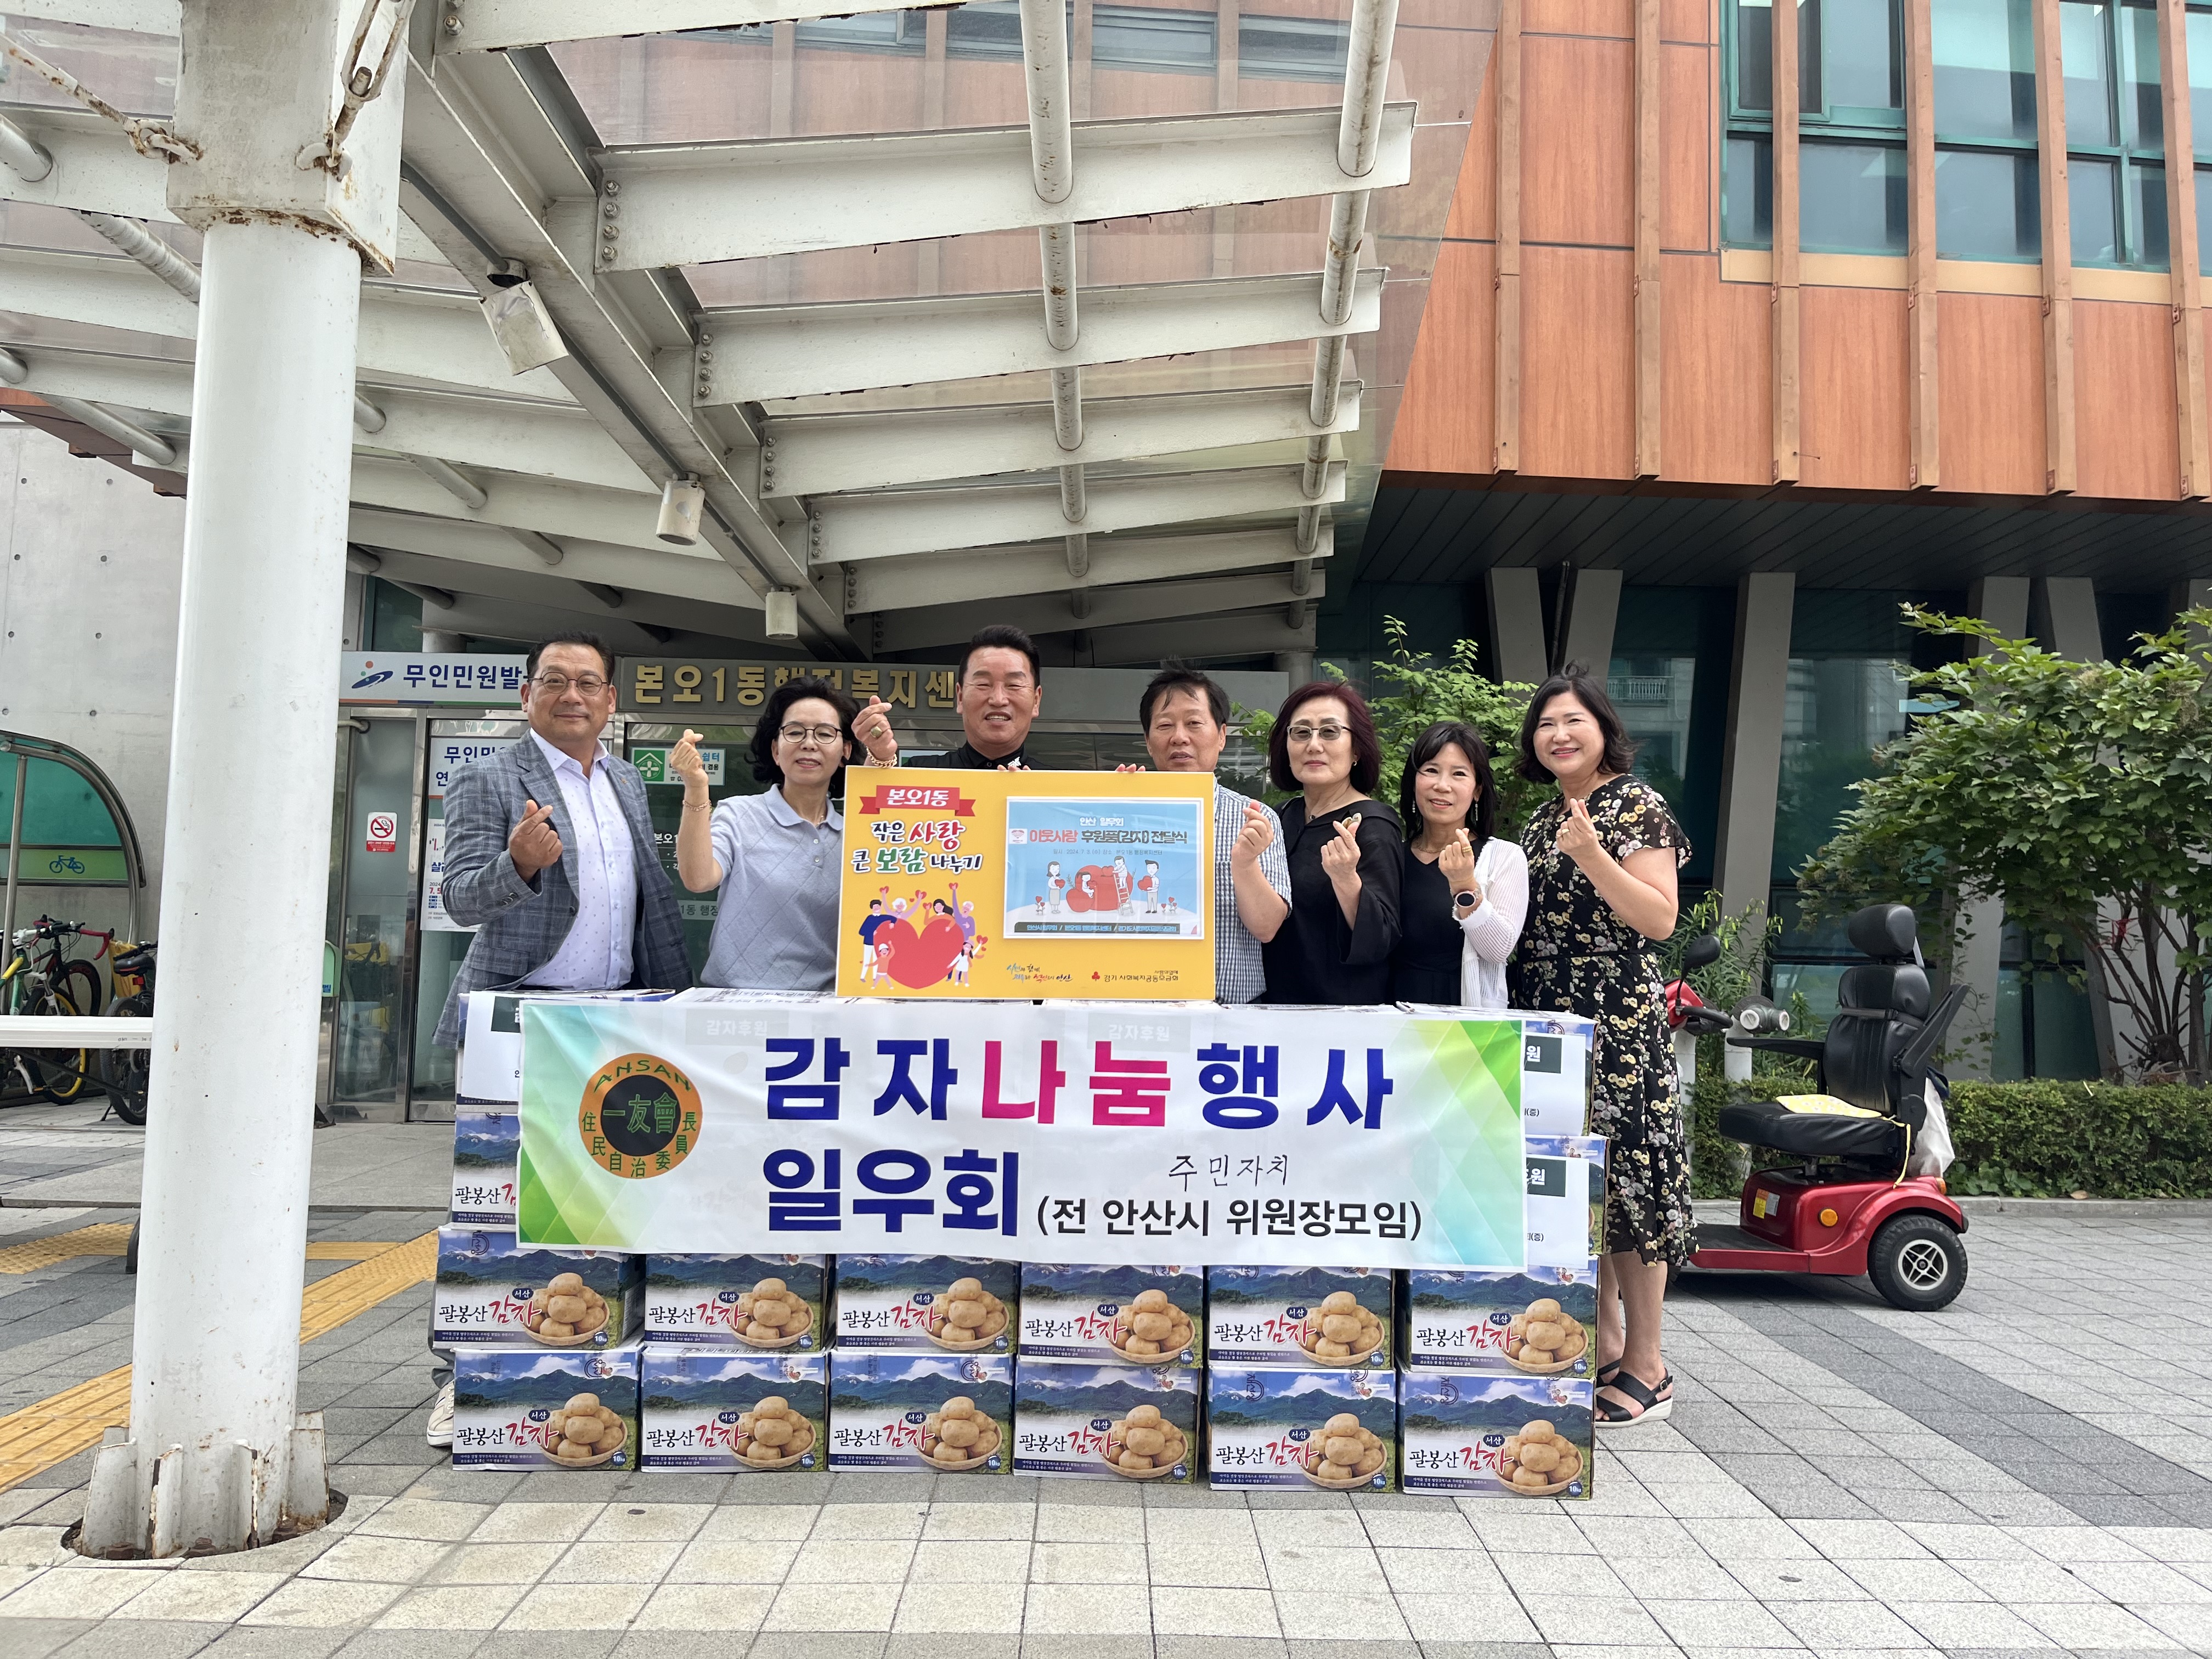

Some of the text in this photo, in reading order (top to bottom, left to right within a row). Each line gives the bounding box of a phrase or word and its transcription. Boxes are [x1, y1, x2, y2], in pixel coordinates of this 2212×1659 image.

[404, 664, 529, 690] 무인민원발
[887, 788, 950, 807] 본오1동
[872, 821, 964, 850] 작은 사랑
[1079, 816, 1097, 827] 안산
[1029, 829, 1187, 844] 이웃사랑 후원품(감자) 전달식
[853, 847, 981, 873] 큰 보람 나누기
[593, 1059, 692, 1093] ANSAN
[603, 1092, 678, 1134] 一友會
[455, 1186, 501, 1205] 팔봉산
[763, 1148, 1019, 1237] 일우회
[1037, 1195, 1423, 1242] (전 안산시 위원장모임)
[515, 1290, 531, 1298] 서산
[721, 1293, 737, 1301] 서산
[916, 1295, 931, 1304] 서산
[439, 1295, 541, 1327] 팔봉산 감자
[649, 1297, 748, 1329] 팔봉산 감자
[842, 1299, 943, 1331] 팔봉산 감자
[1099, 1306, 1116, 1314] 서산
[1289, 1308, 1305, 1317] 서산
[1492, 1314, 1509, 1323] 서산
[1025, 1310, 1127, 1344] 팔봉산 감자
[1214, 1313, 1317, 1346] 팔봉산 감자
[1417, 1319, 1521, 1353] 팔봉산 감자
[721, 1414, 737, 1422] 서산
[907, 1413, 923, 1422] 서산
[1093, 1420, 1109, 1429] 서산
[456, 1416, 559, 1449] 팔봉산 감자
[646, 1418, 749, 1449] 팔봉산 감자
[834, 1418, 935, 1451] 팔봉산 감자
[1019, 1425, 1120, 1458] 팔봉산 감자
[1291, 1431, 1307, 1439] 서산
[1216, 1435, 1319, 1469] 팔봉산 감자
[1409, 1440, 1514, 1475] 팔봉산 감자
